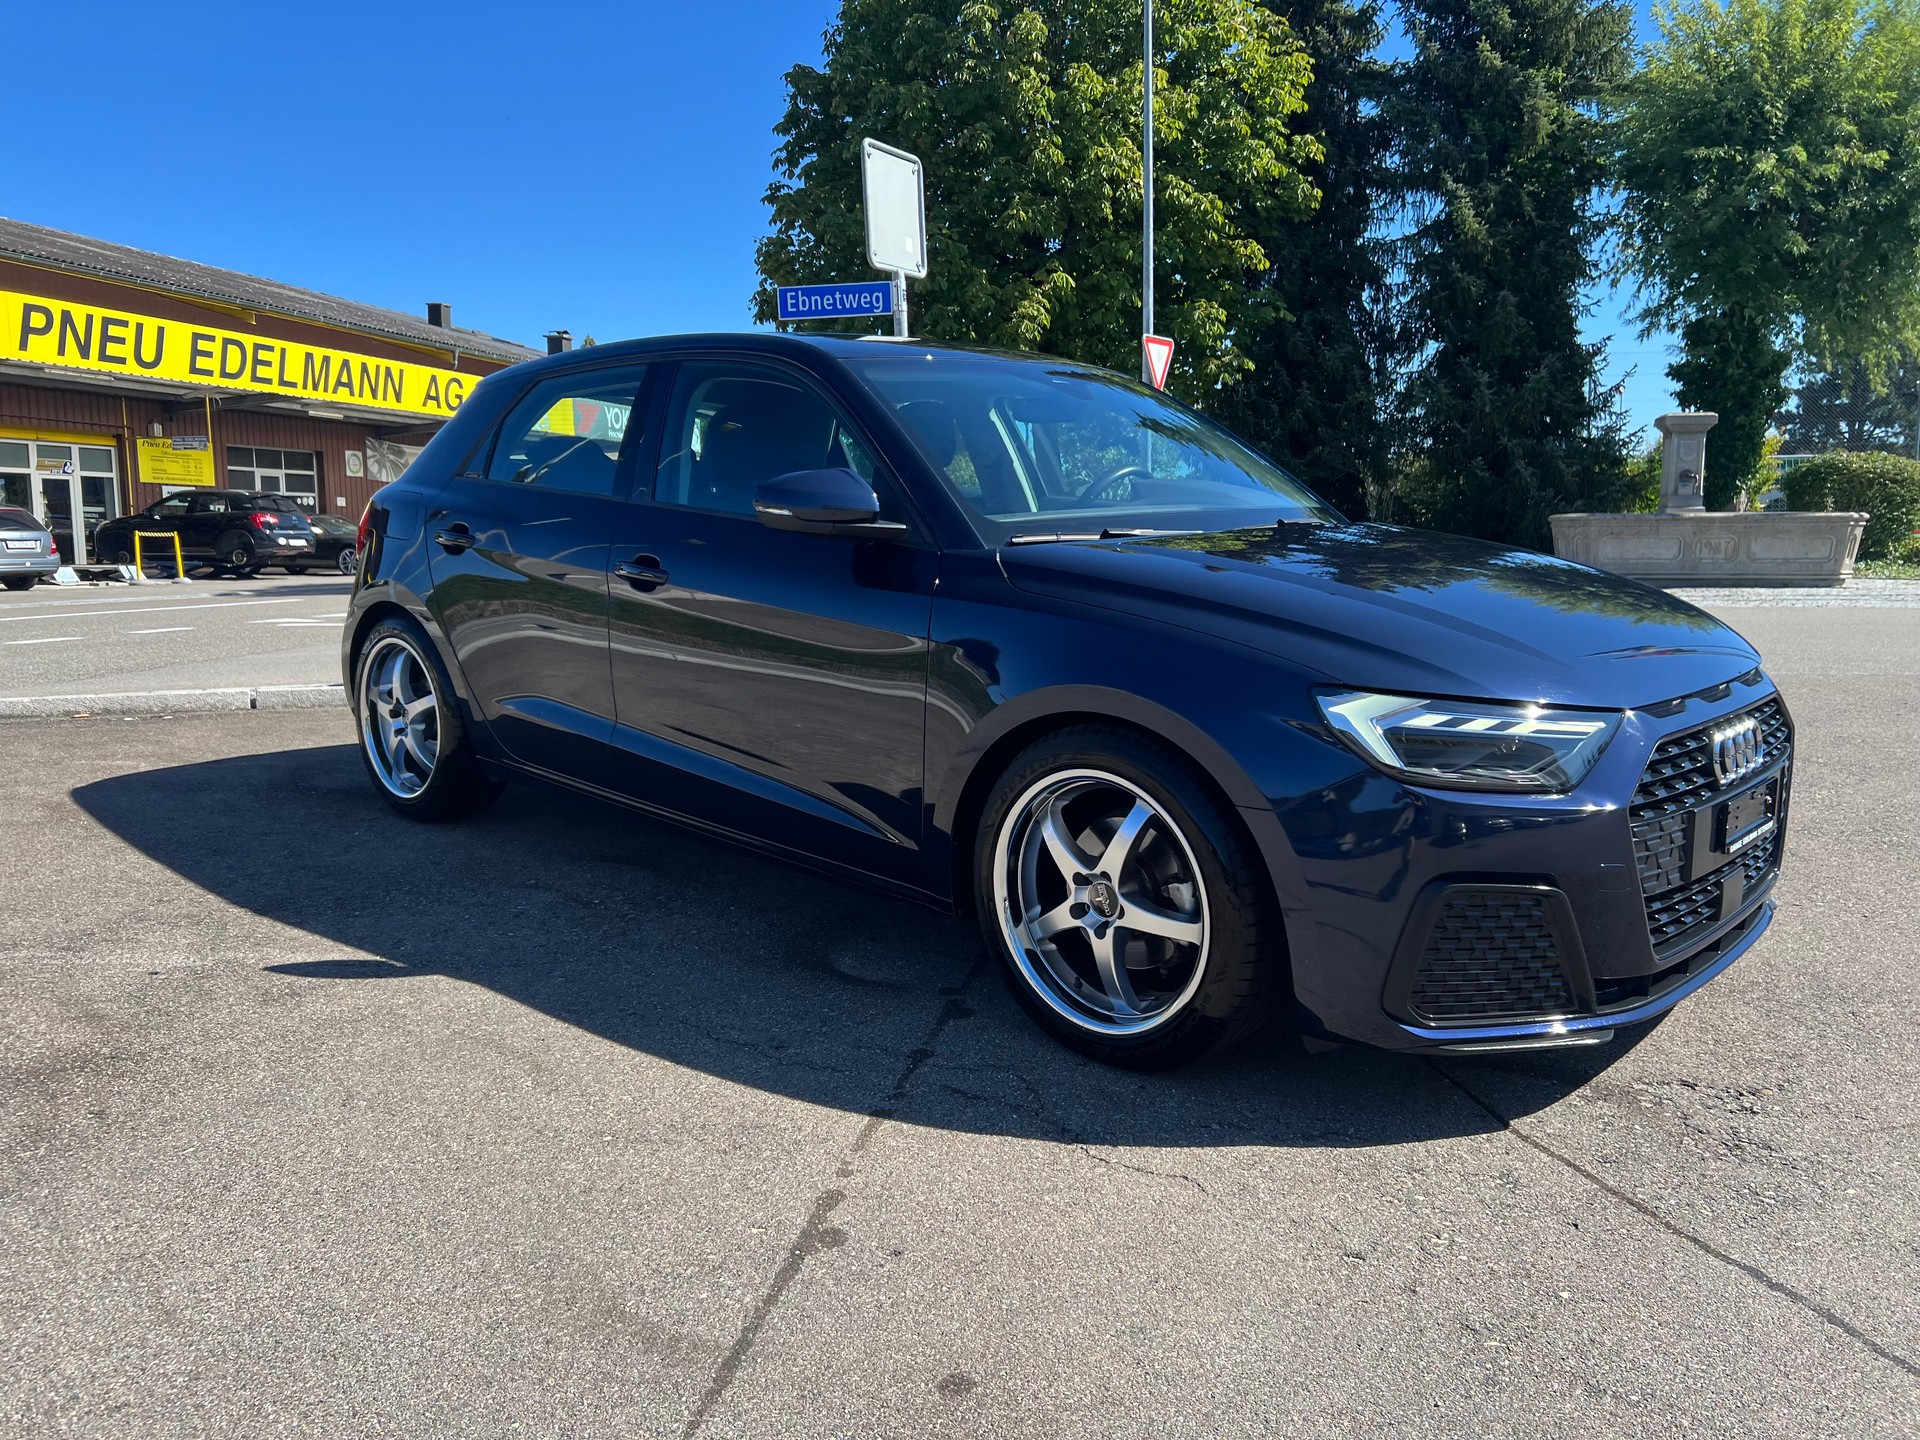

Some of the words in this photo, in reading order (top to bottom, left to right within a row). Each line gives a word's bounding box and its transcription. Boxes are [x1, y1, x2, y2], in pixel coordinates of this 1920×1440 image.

[787, 290, 884, 313] Ebnetweg
[18, 302, 165, 370] PNEU
[188, 331, 404, 404] EDELMANN
[422, 374, 464, 411] AG
[142, 440, 160, 448] Pneu
